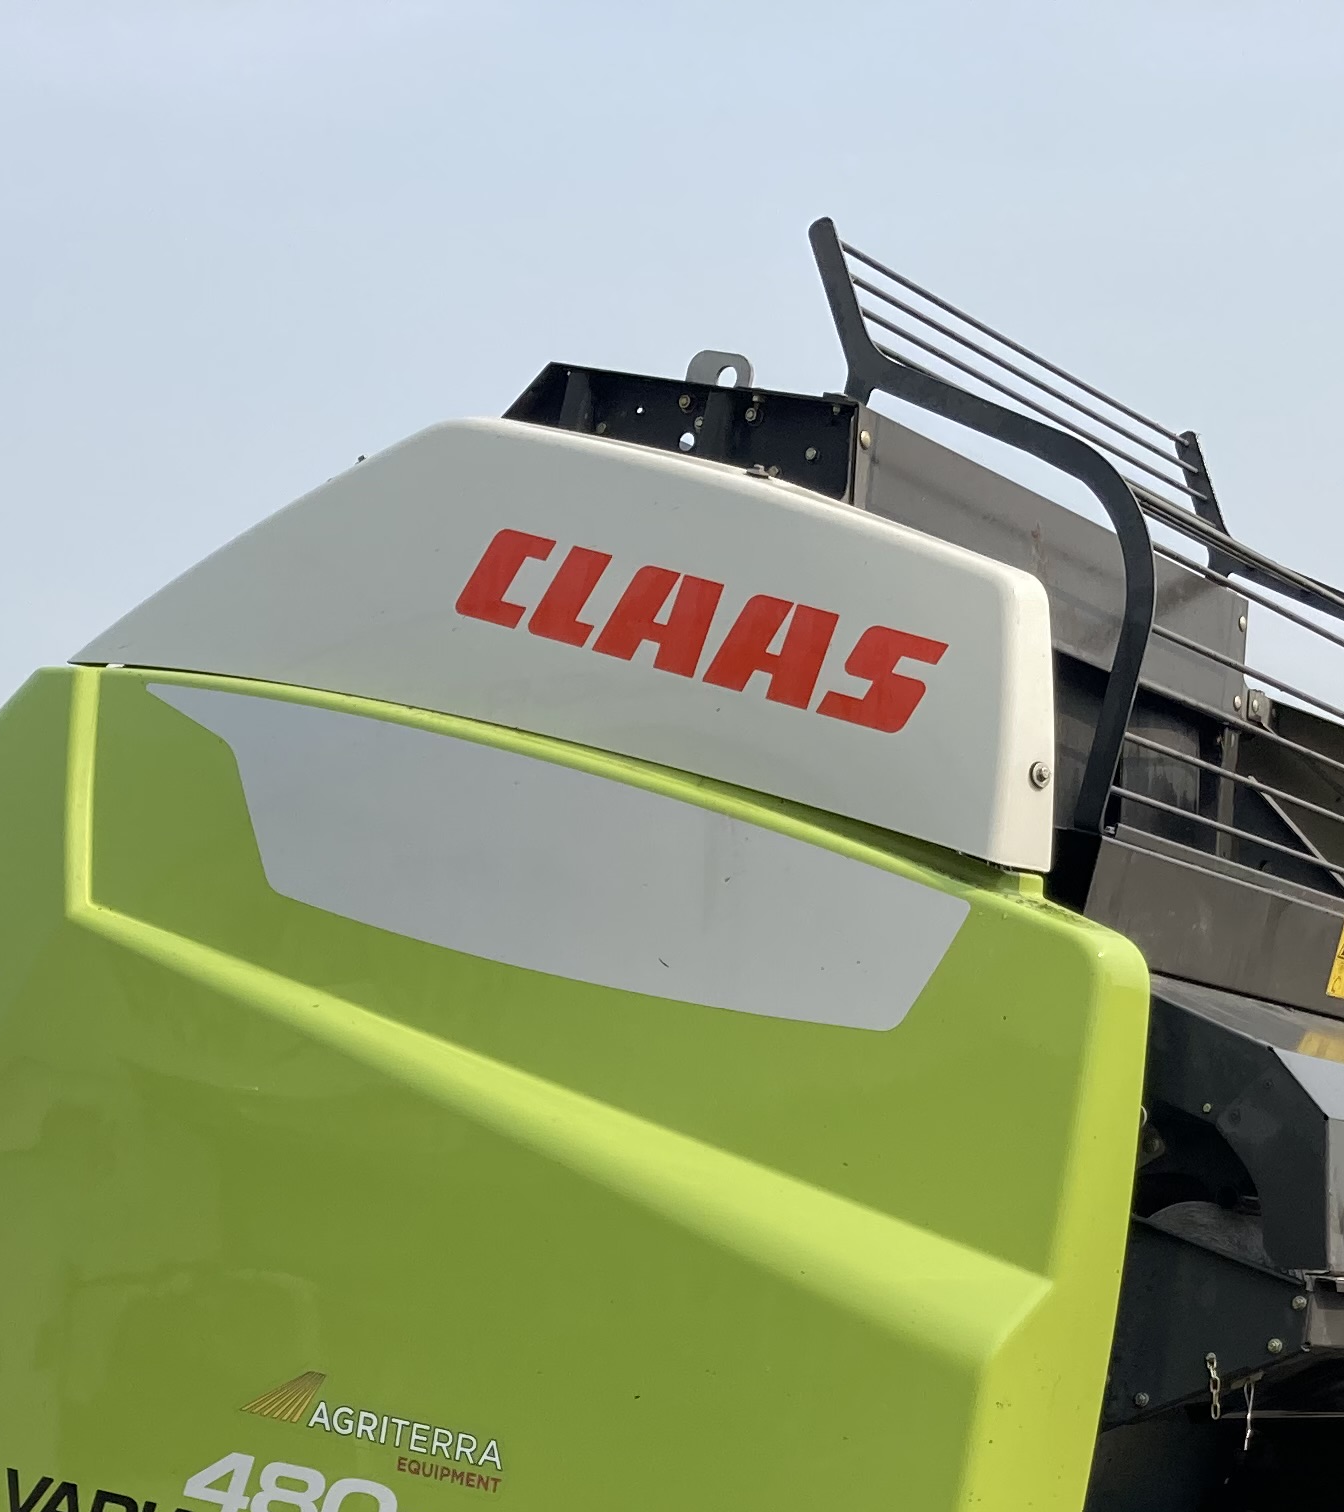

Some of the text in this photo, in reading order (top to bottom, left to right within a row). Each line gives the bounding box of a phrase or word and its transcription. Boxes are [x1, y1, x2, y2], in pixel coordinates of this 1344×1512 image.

[455, 528, 950, 734] CLAAS
[307, 1400, 502, 1470] AGRITERRA
[396, 1456, 502, 1494] EQUIPMENT
